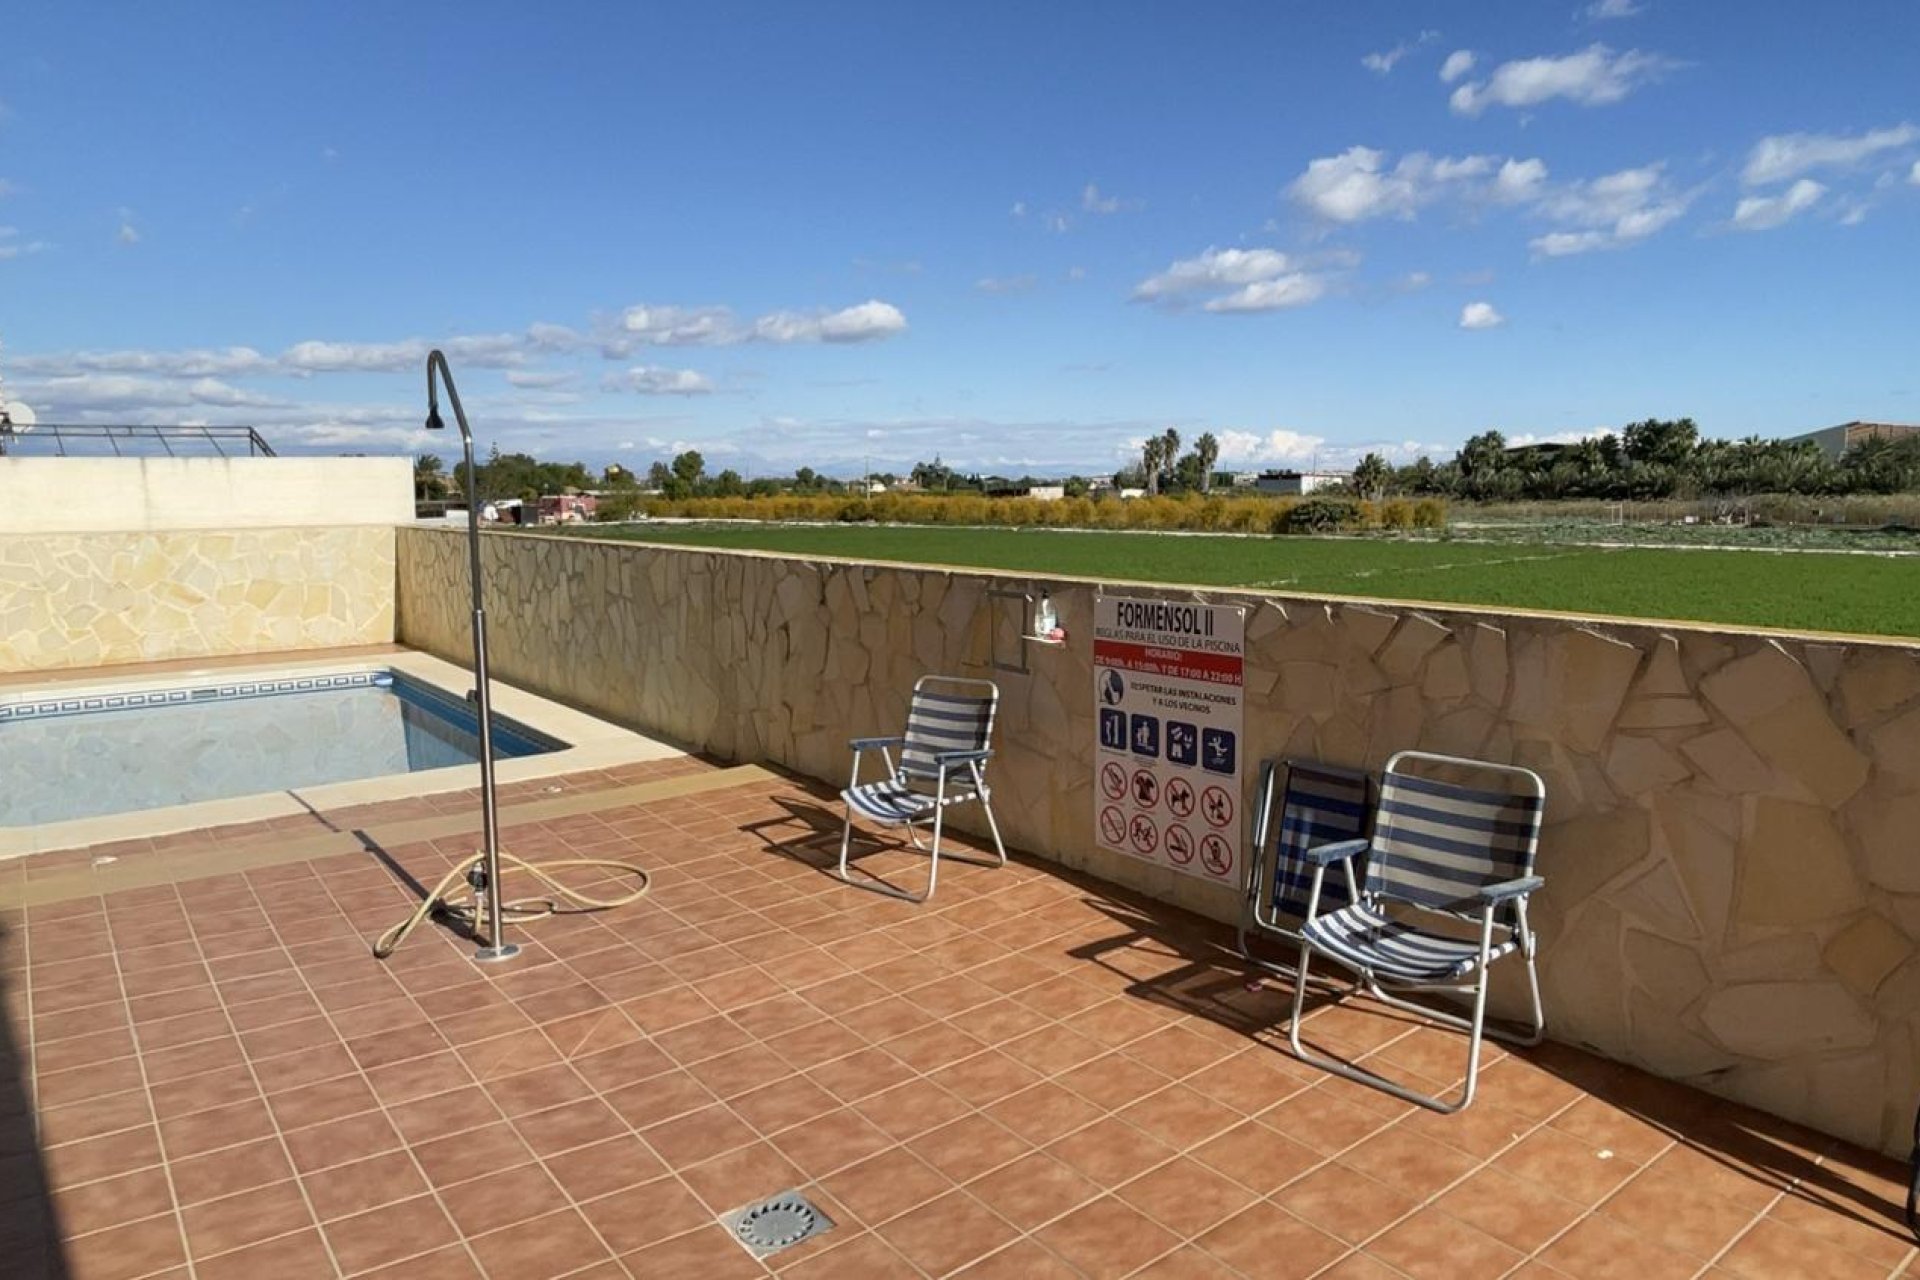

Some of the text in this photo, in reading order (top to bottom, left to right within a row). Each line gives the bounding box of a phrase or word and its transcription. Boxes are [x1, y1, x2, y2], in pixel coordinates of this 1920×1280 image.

[1117, 601, 1213, 636] FORMENSOL II
[1096, 627, 1240, 653] REGLAS PARA EL USO DE LA PISCINA
[1168, 665, 1179, 676] DE
[1203, 669, 1209, 680] A
[1131, 682, 1237, 706] RESPETAR LAS INSTALACIONES
[1165, 699, 1178, 709] LOS
[1179, 701, 1211, 715] VECINOS
